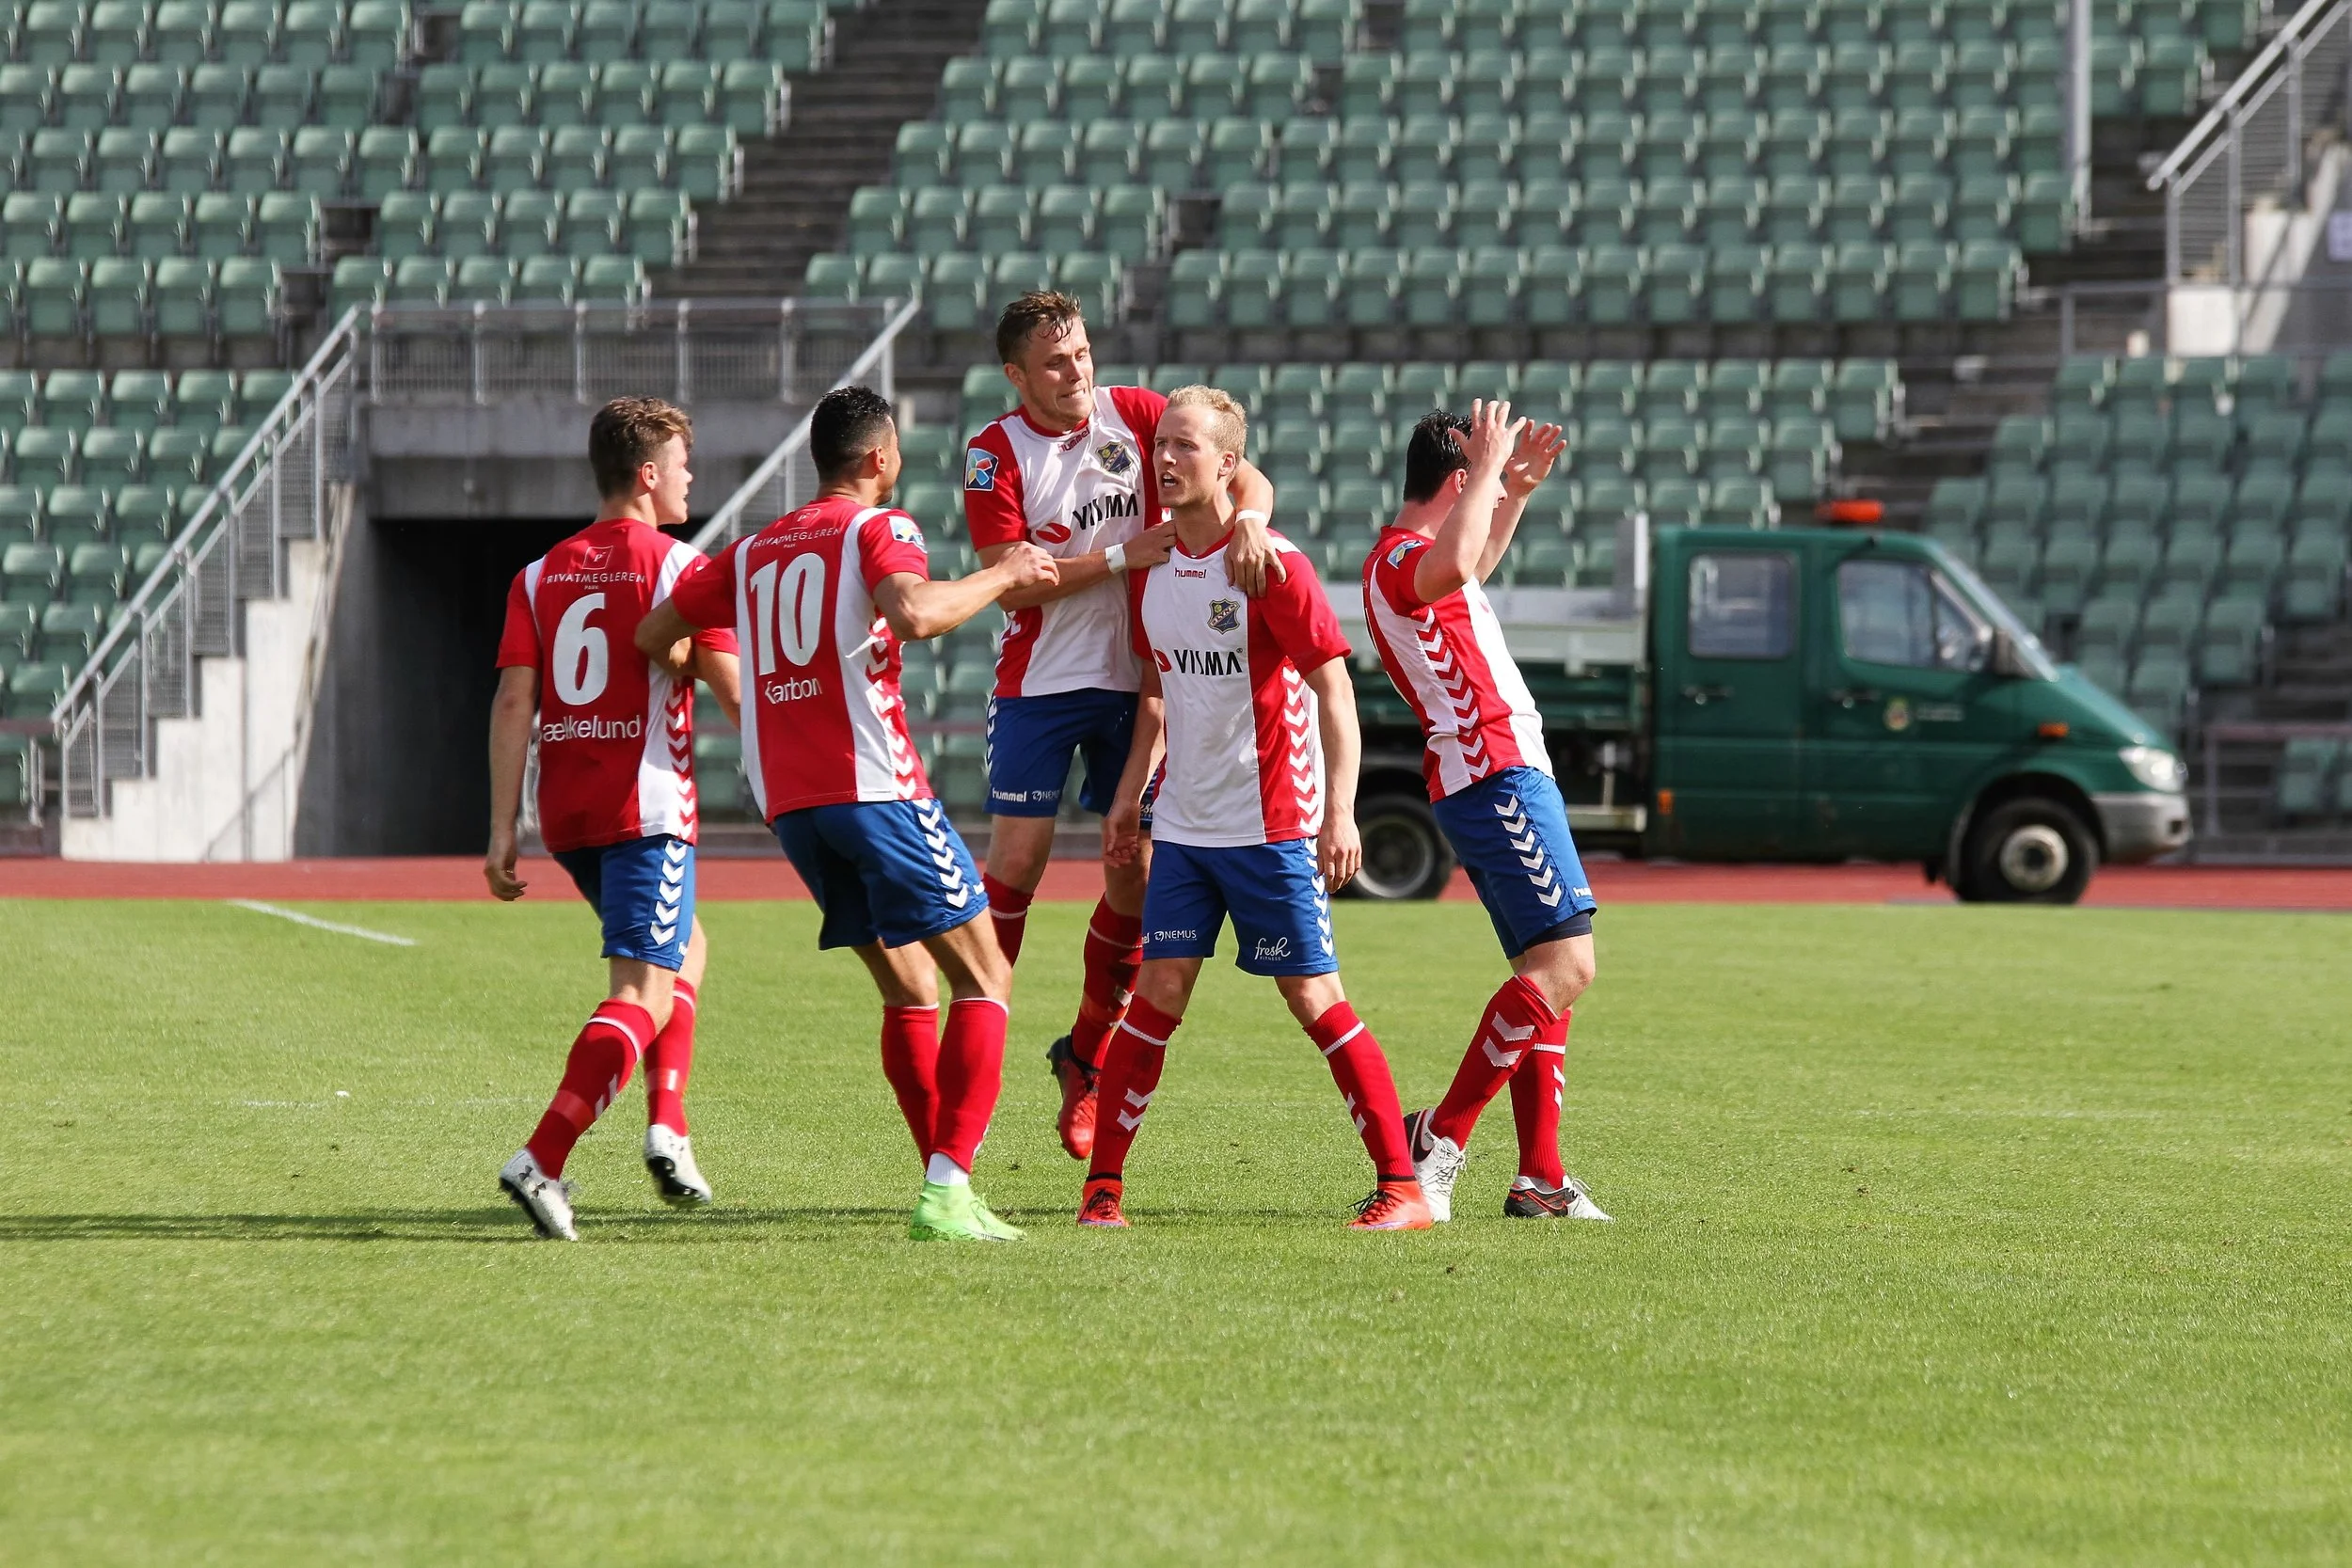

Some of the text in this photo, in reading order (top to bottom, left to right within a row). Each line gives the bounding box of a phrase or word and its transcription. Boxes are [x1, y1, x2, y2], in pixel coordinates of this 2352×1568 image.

[1072, 493, 1139, 531] VISMA
[1174, 566, 1207, 578] hummel
[750, 552, 826, 676] 10
[552, 593, 609, 706] 6
[1173, 648, 1243, 675] VISMA
[765, 676, 823, 705] Karbon
[992, 787, 1027, 802] hummel
[1165, 929, 1197, 940] NEMUS
[1254, 937, 1291, 959] fresh
